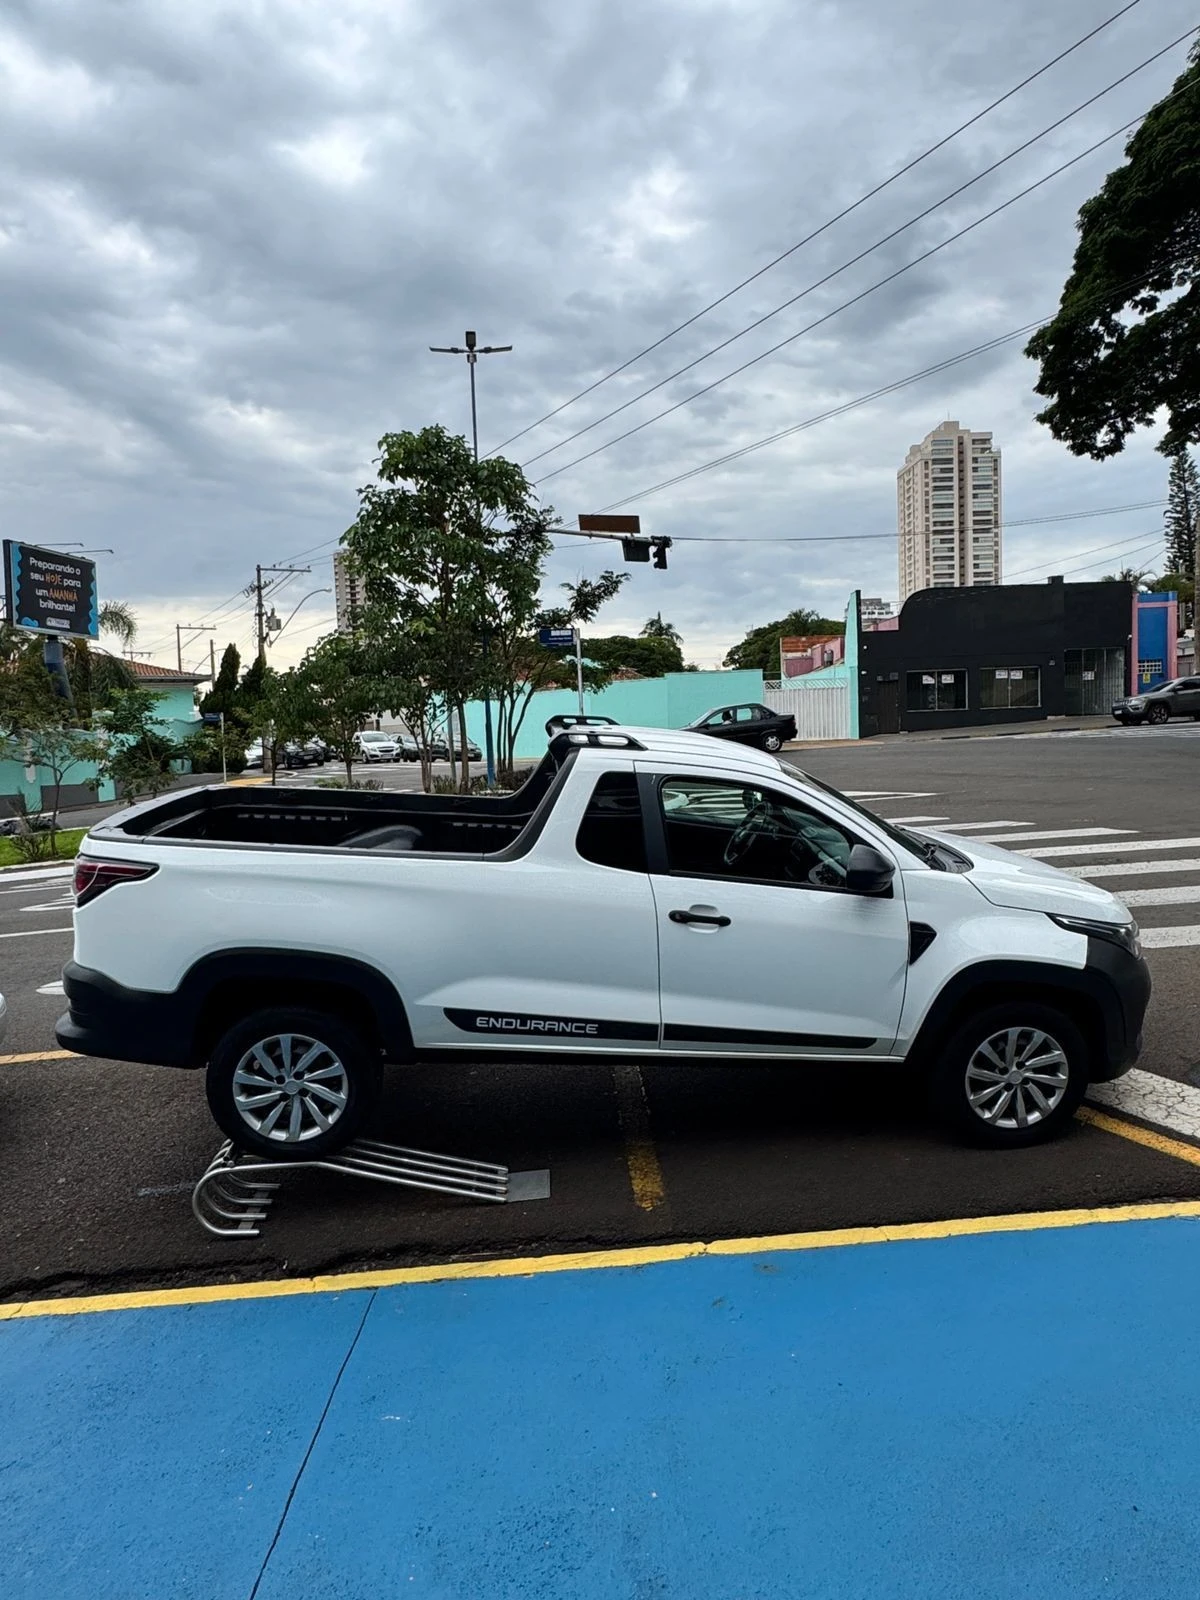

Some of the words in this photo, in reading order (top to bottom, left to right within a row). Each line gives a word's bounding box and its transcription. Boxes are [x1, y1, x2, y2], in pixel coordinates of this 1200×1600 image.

[29, 557, 74, 573] Preparando
[30, 572, 44, 581] seu
[45, 573, 62, 585] HOJE
[63, 578, 81, 588] para
[35, 588, 48, 596] um
[49, 588, 77, 601] AMANHÃ
[39, 599, 75, 612] brilhante!
[476, 1016, 599, 1034] ENDURANCE
